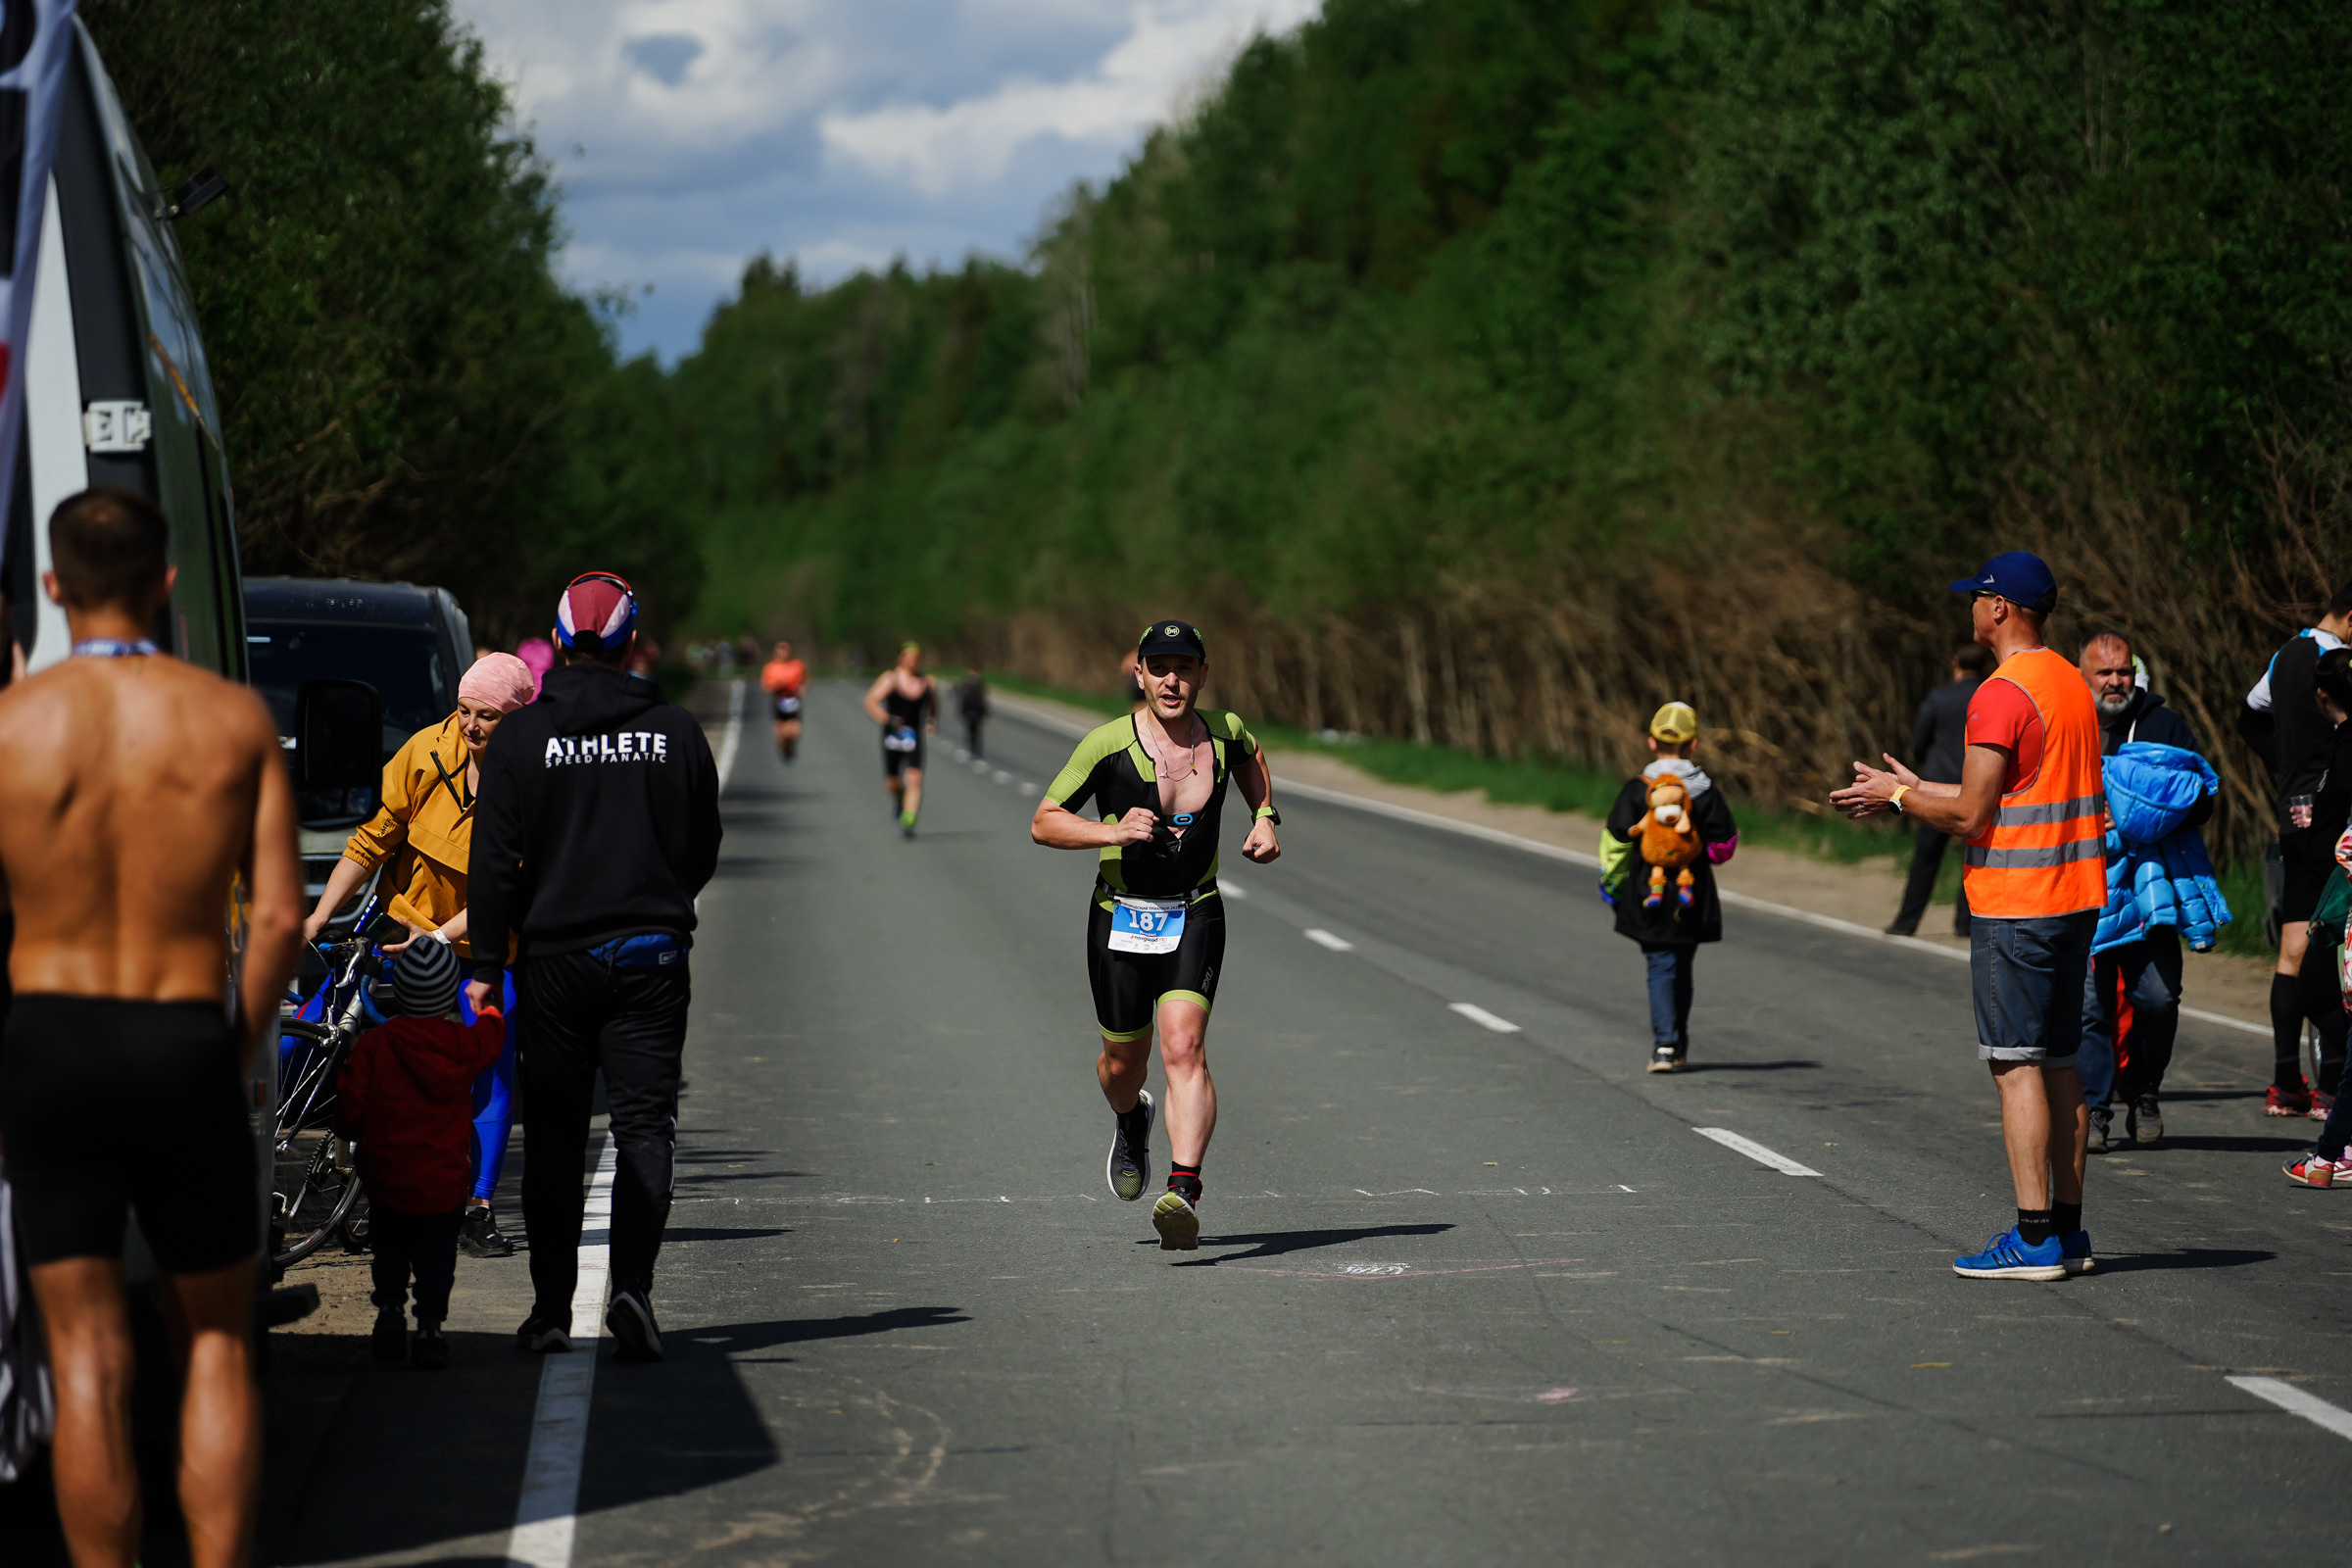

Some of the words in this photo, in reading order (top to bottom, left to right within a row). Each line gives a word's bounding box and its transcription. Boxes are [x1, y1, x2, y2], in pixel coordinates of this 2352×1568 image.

[545, 732, 666, 759] ATHLETE
[545, 755, 593, 768] SPEED
[601, 752, 666, 763] FANATIC
[1129, 909, 1169, 931] 187
